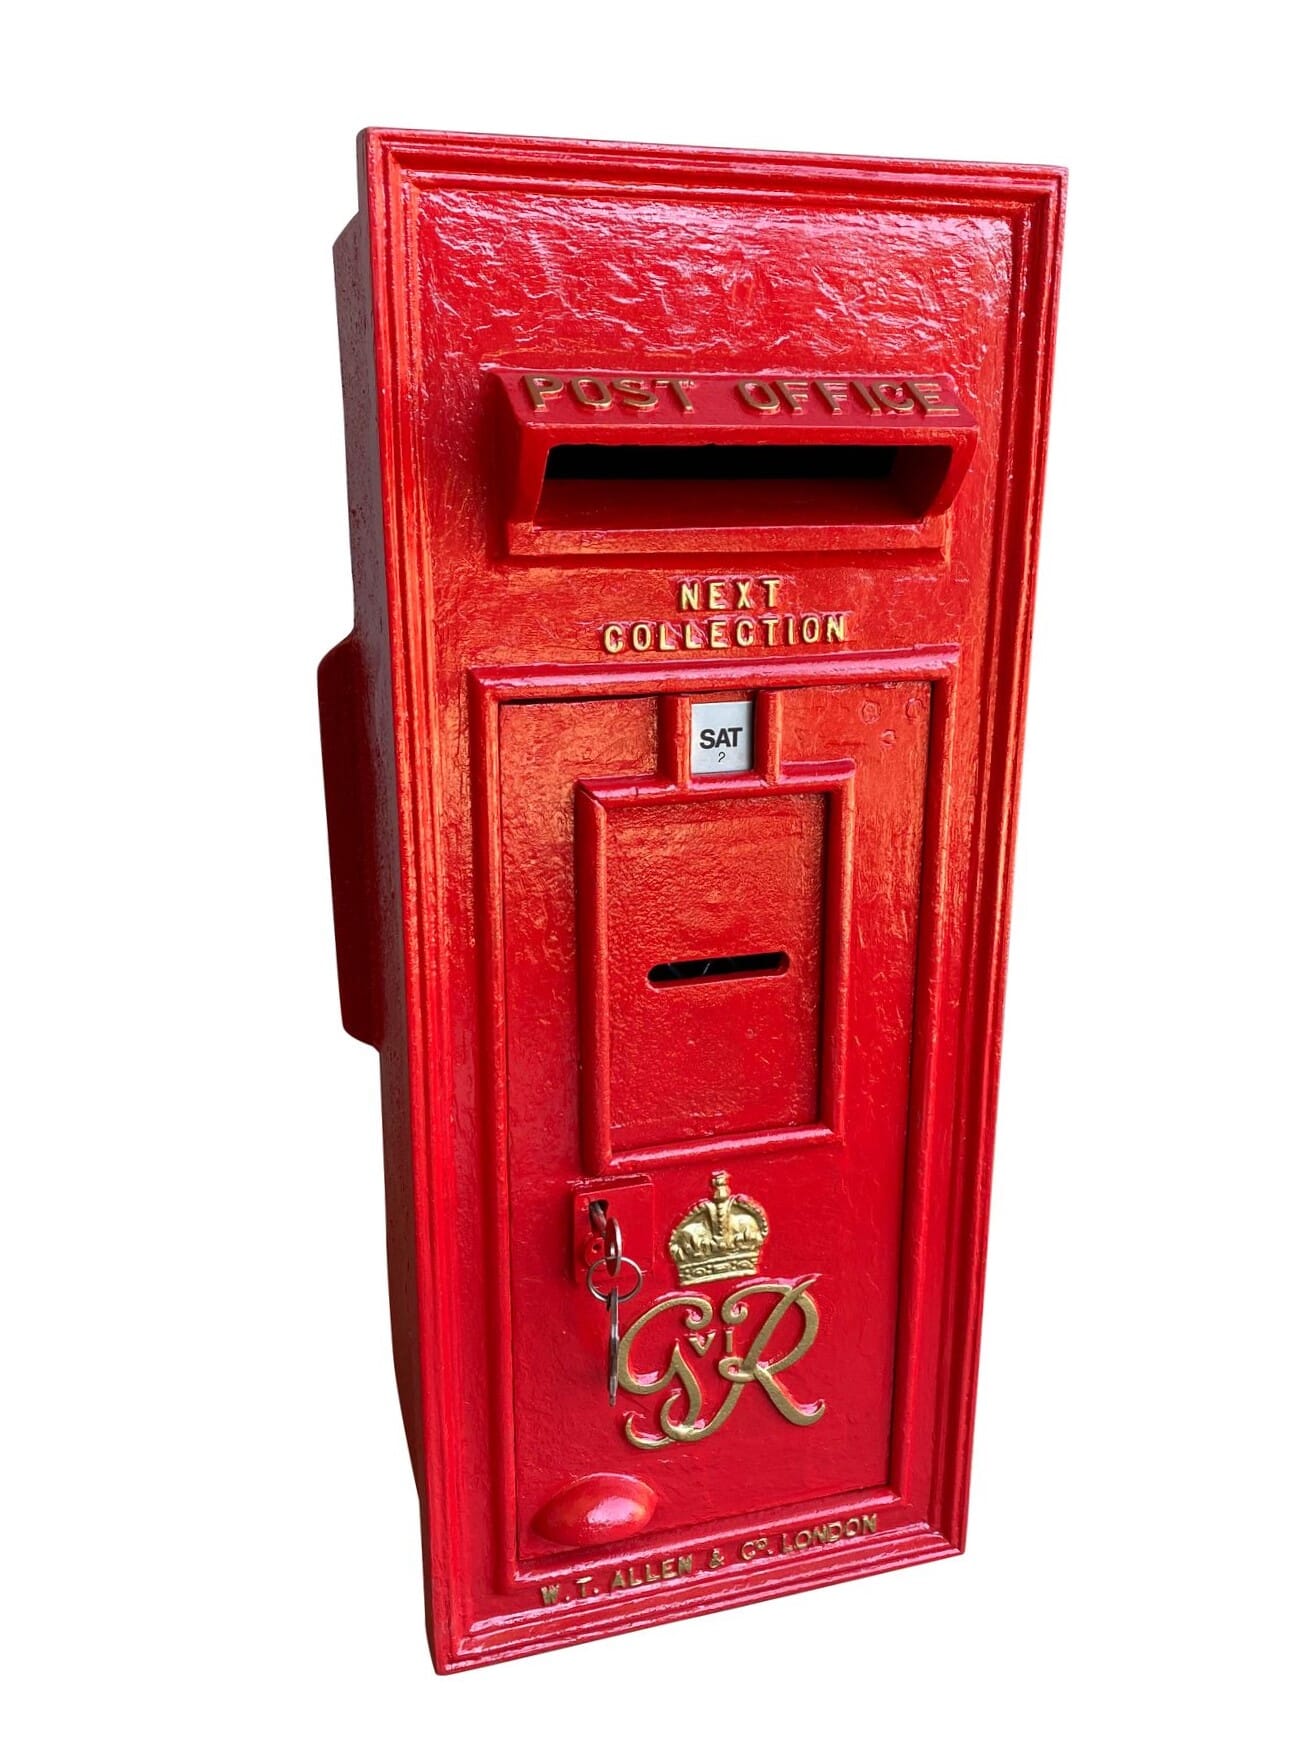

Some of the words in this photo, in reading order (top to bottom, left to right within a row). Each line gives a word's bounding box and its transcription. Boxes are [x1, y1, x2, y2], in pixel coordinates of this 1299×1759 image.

[520, 374, 696, 413] POST
[736, 379, 959, 416] OFFICE
[681, 578, 781, 611] NEXT
[604, 615, 846, 653] COLLECTION
[699, 727, 743, 749] SAT
[611, 1554, 693, 1592] ALLEN
[709, 1547, 725, 1569] &
[781, 1512, 877, 1554] LONDON
